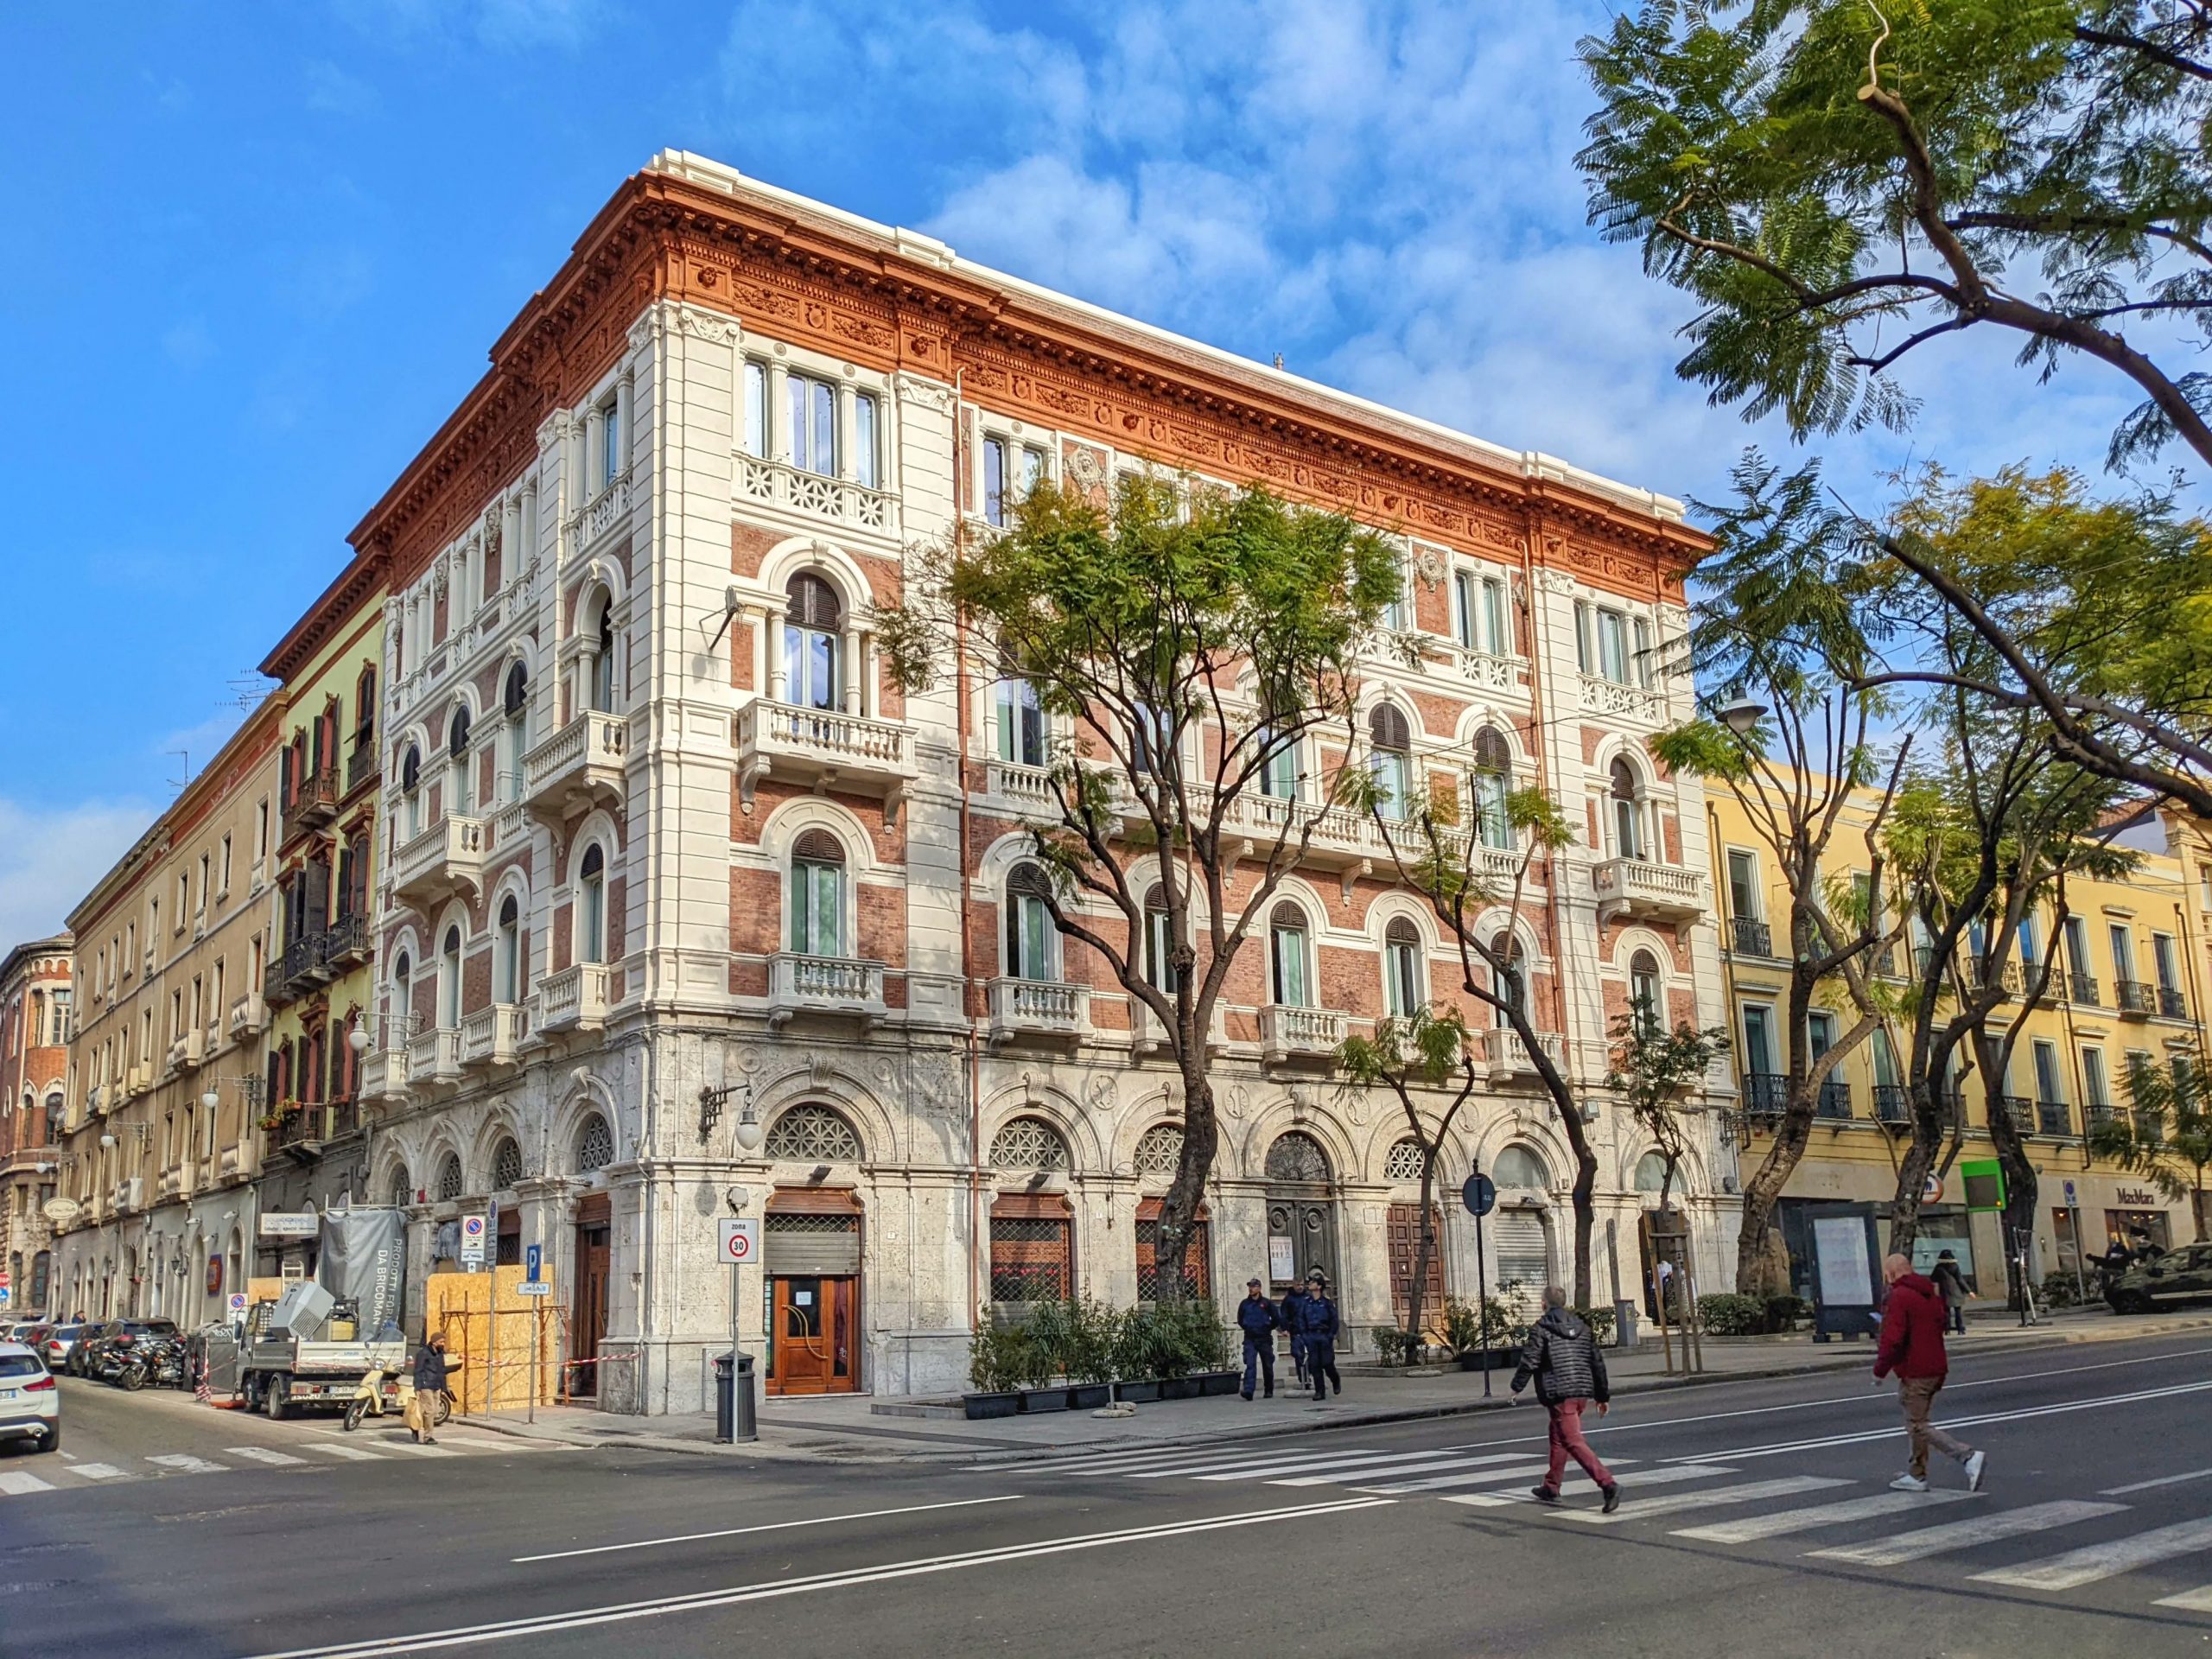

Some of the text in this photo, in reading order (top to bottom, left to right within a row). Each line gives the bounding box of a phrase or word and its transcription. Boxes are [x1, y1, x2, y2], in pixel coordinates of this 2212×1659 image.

[2116, 1187, 2155, 1205] MaxMara
[734, 1241, 744, 1250] 30
[388, 1238, 403, 1292] PRODOTTI
[529, 1249, 537, 1279] P
[372, 1249, 388, 1325] DA BRICOMAN
